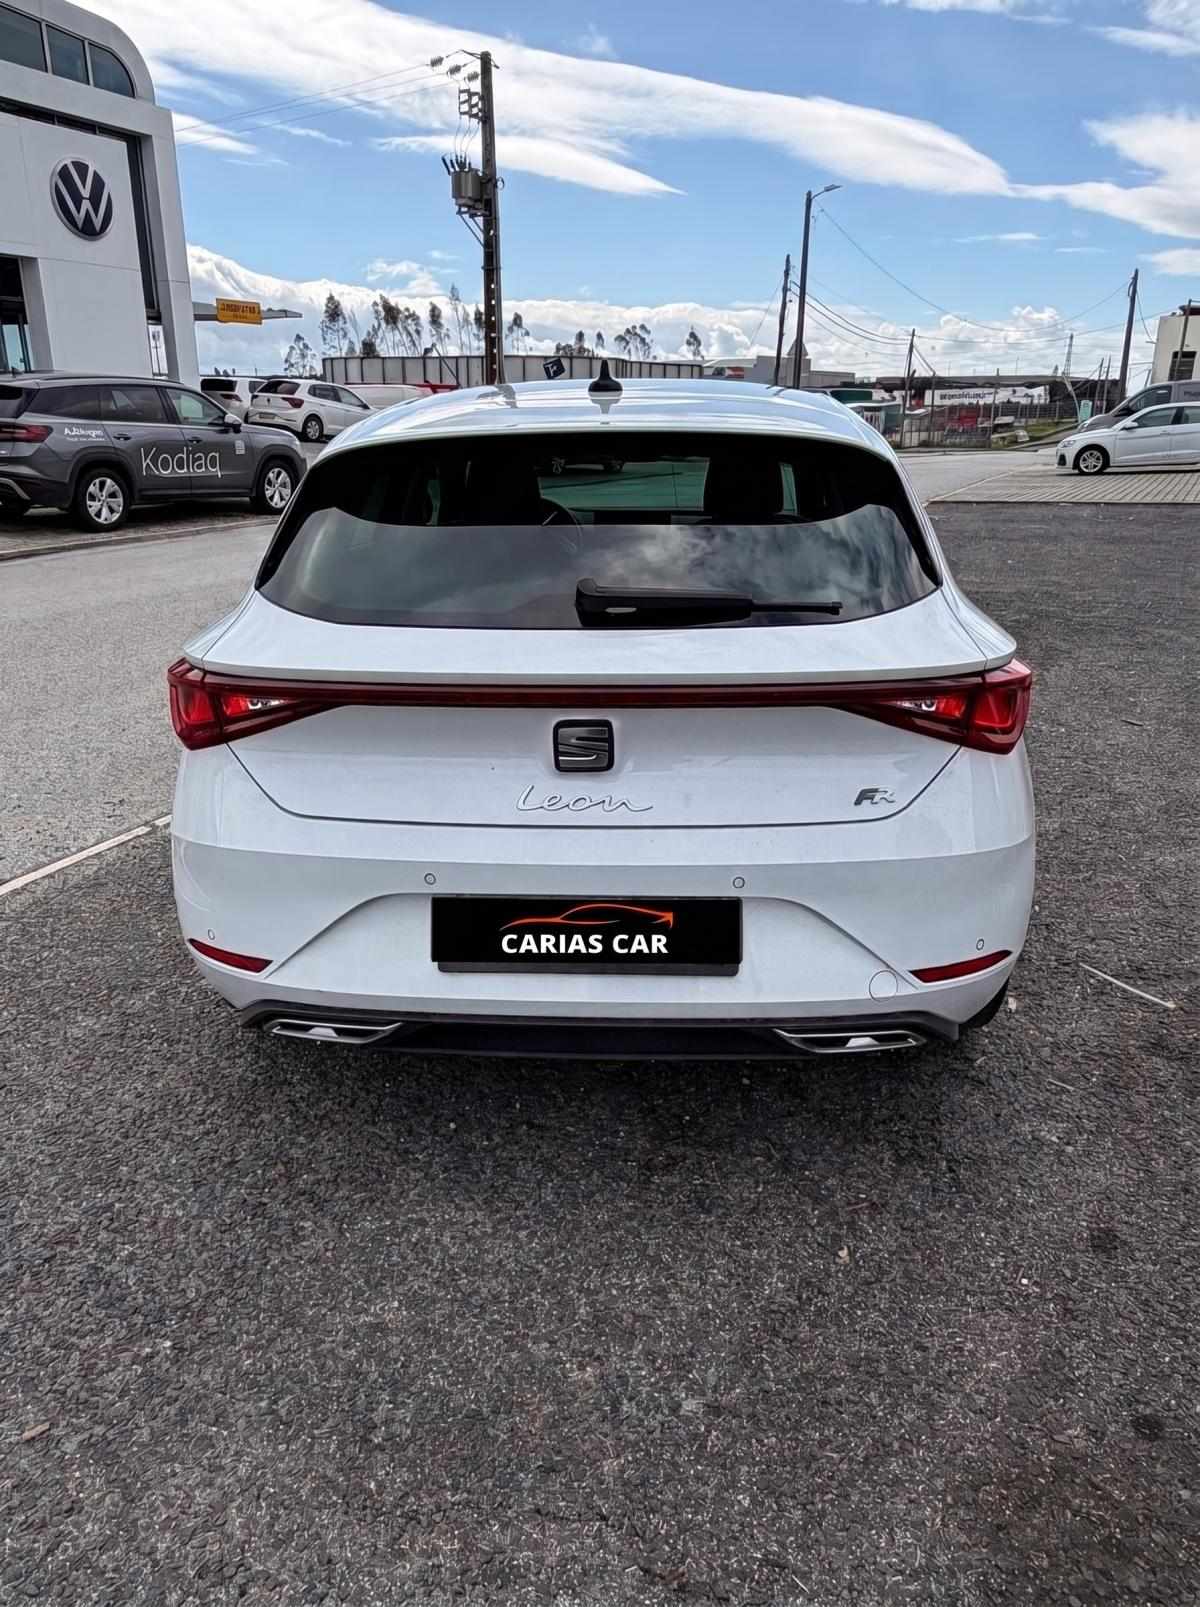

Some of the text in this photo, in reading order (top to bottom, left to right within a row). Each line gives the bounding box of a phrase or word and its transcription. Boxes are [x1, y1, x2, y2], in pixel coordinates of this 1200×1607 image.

[141, 446, 222, 478] Kodiaq
[516, 784, 654, 813] Leon
[854, 787, 896, 806] FR
